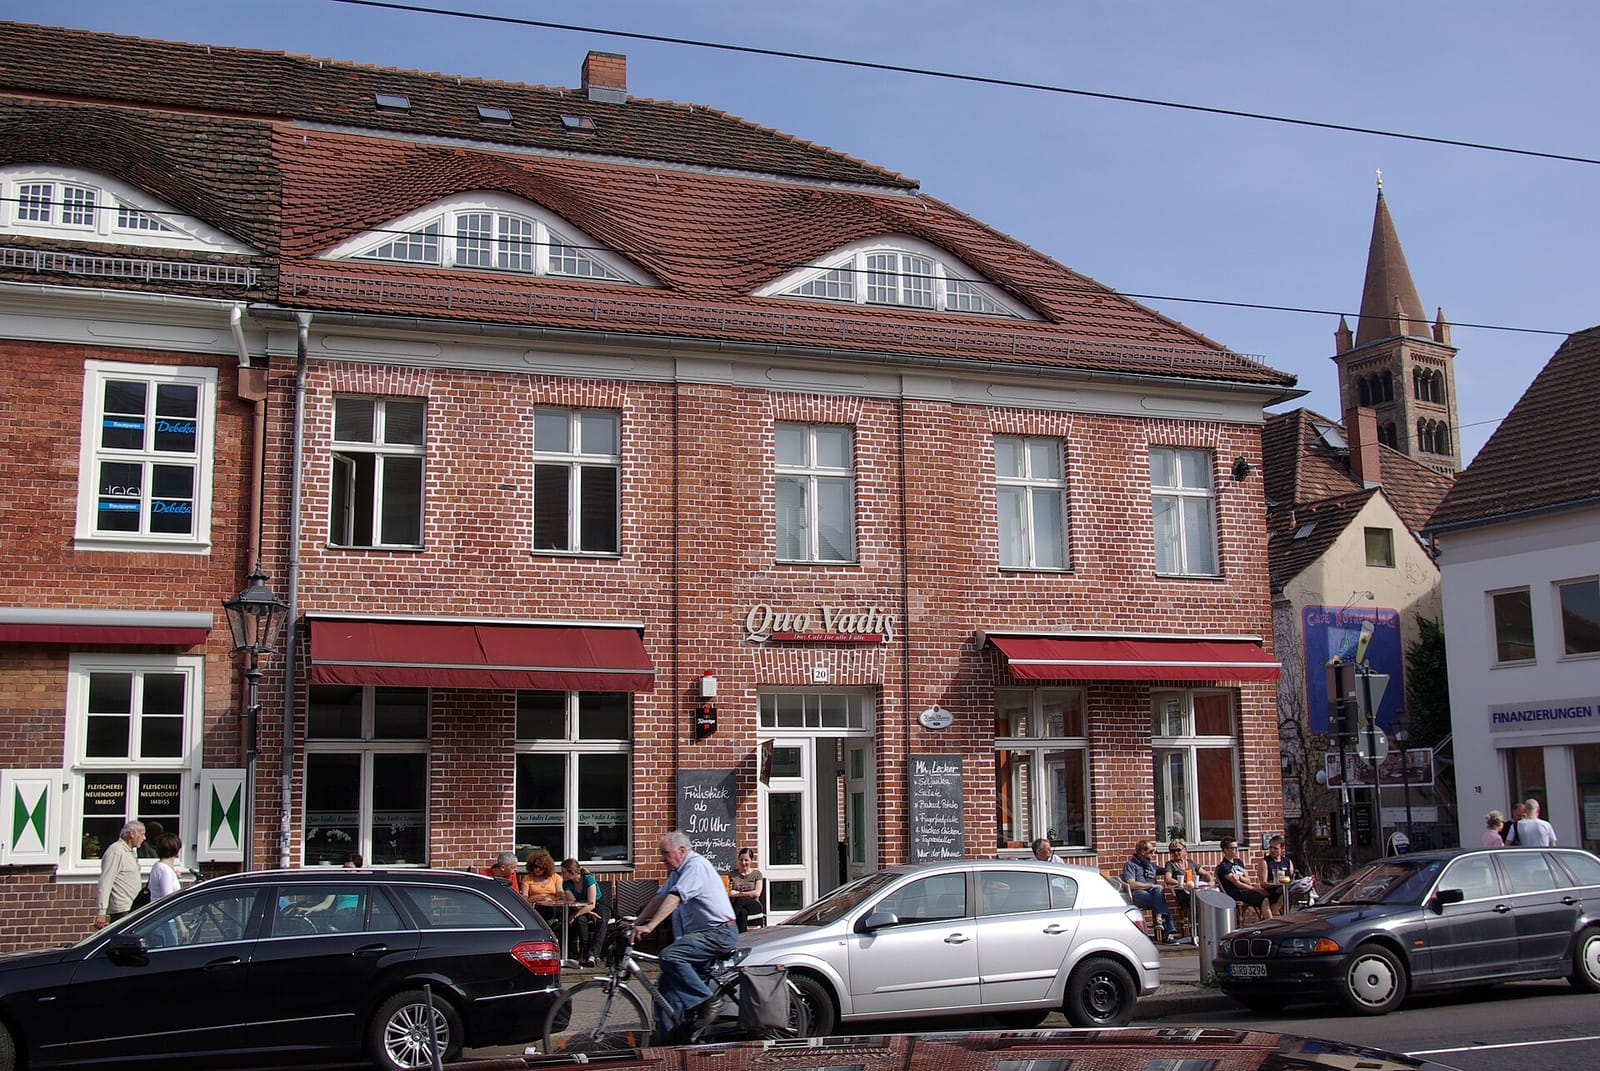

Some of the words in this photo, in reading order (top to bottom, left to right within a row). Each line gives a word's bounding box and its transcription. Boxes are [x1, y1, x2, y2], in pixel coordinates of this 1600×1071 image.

[155, 420, 196, 434] Debeka
[151, 500, 192, 514] Debeka
[744, 603, 810, 643] Quo
[819, 605, 897, 644] Vadis
[815, 670, 826, 679] 20
[1492, 706, 1592, 724] FINANZIERUNGEN
[932, 760, 959, 773] Lecker
[683, 784, 730, 801] Frühstück
[694, 800, 708, 812] ab
[686, 814, 709, 834] 9.00
[710, 815, 731, 833] Uhr
